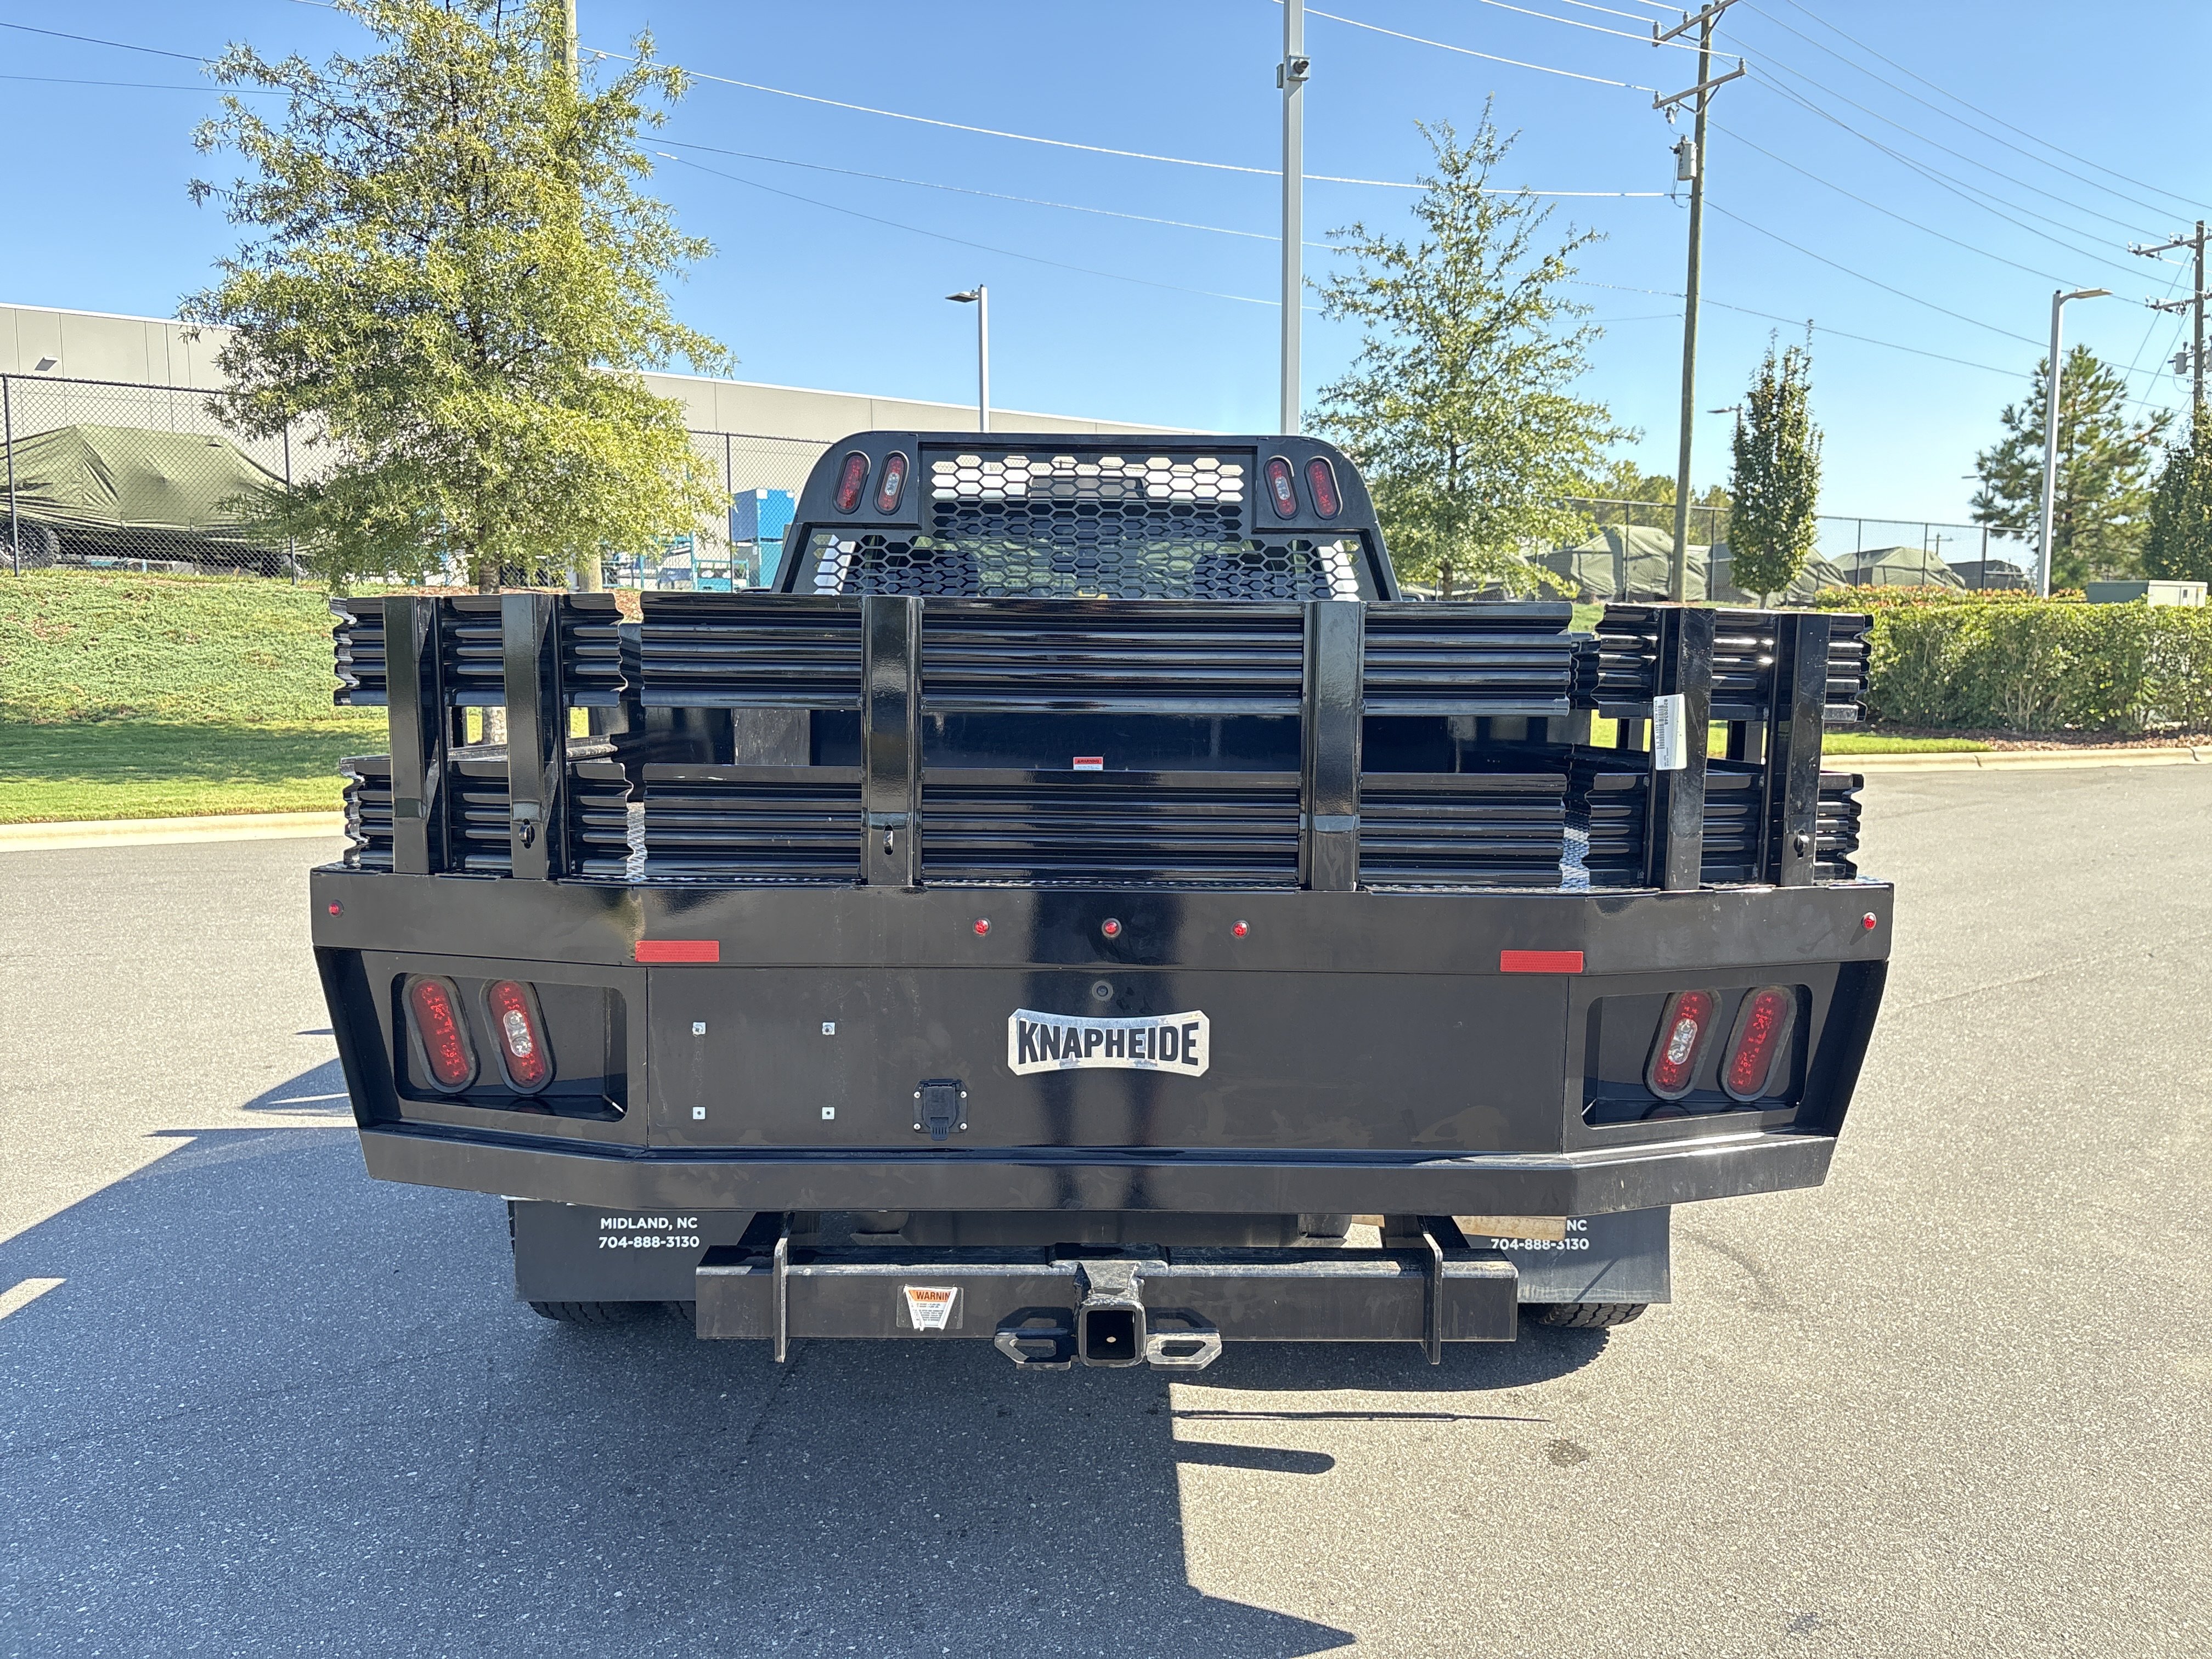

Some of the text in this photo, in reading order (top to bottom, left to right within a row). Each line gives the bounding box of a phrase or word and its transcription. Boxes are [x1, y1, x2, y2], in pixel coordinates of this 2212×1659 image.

[1018, 1020, 1199, 1066] KNAPHEIDE
[600, 1217, 698, 1231] MIDLAND, NC
[1566, 1220, 1587, 1231] NC
[598, 1236, 700, 1249] 704-888-3130
